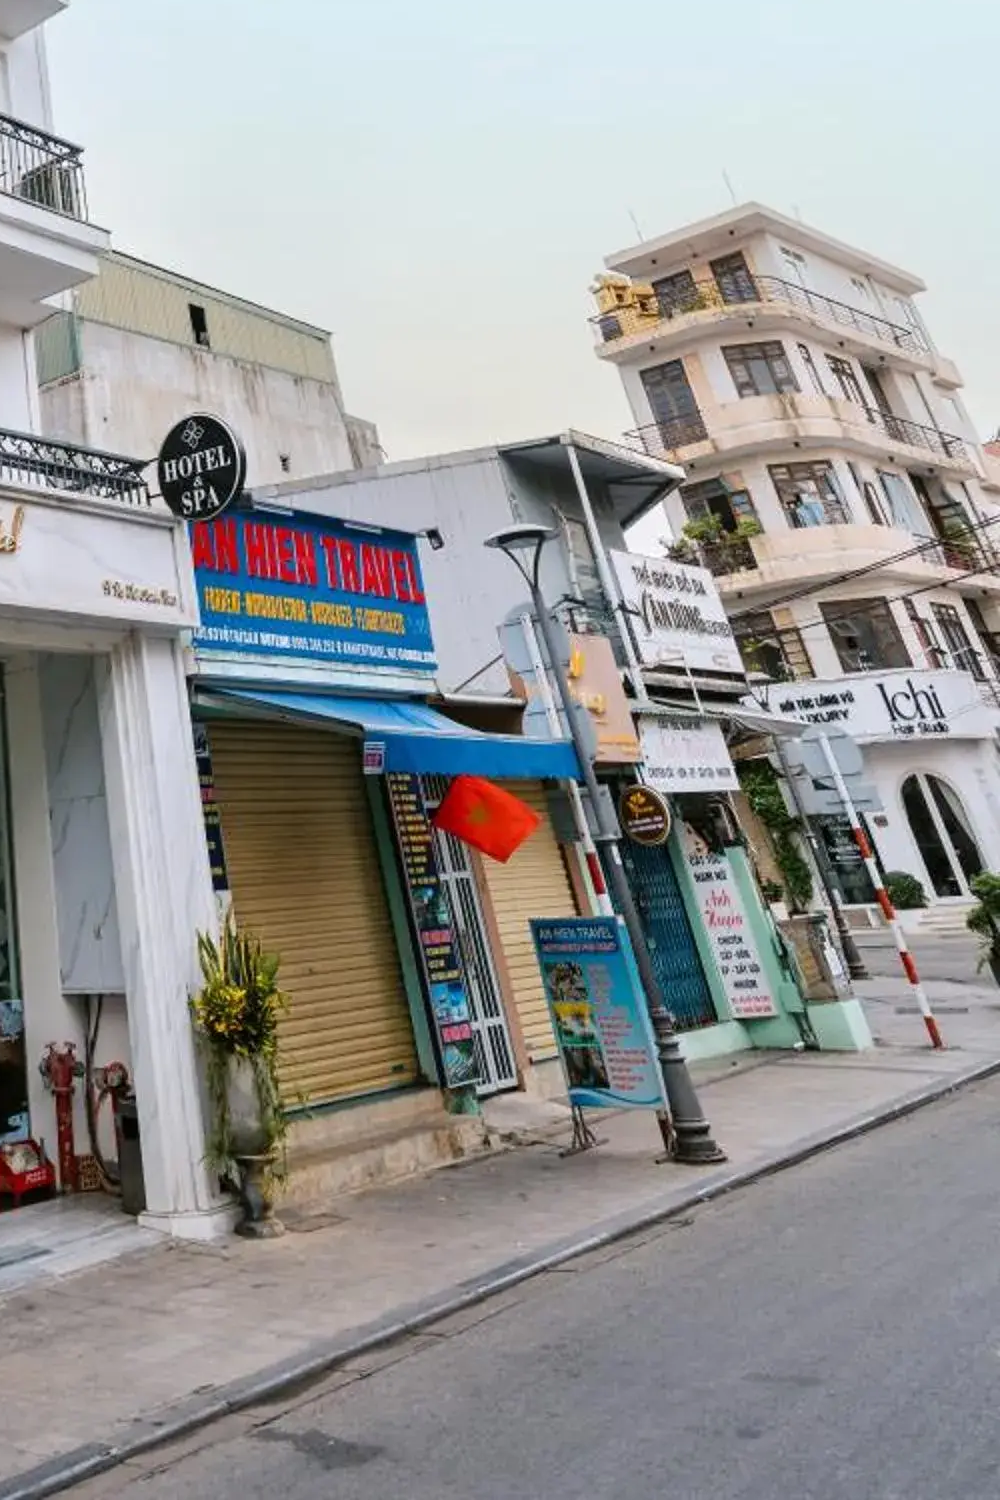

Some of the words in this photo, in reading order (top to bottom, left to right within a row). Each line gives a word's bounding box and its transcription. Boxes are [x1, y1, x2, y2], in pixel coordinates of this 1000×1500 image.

[163, 445, 231, 483] HOTEL
[181, 487, 220, 515] SPA
[191, 518, 239, 573] AN
[243, 523, 317, 587] HIEN
[320, 535, 426, 605] TRAVEL
[876, 678, 947, 722] Ichi
[891, 722, 915, 735] Hair
[917, 720, 950, 734] Studio
[576, 926, 615, 940] TRAVEL
